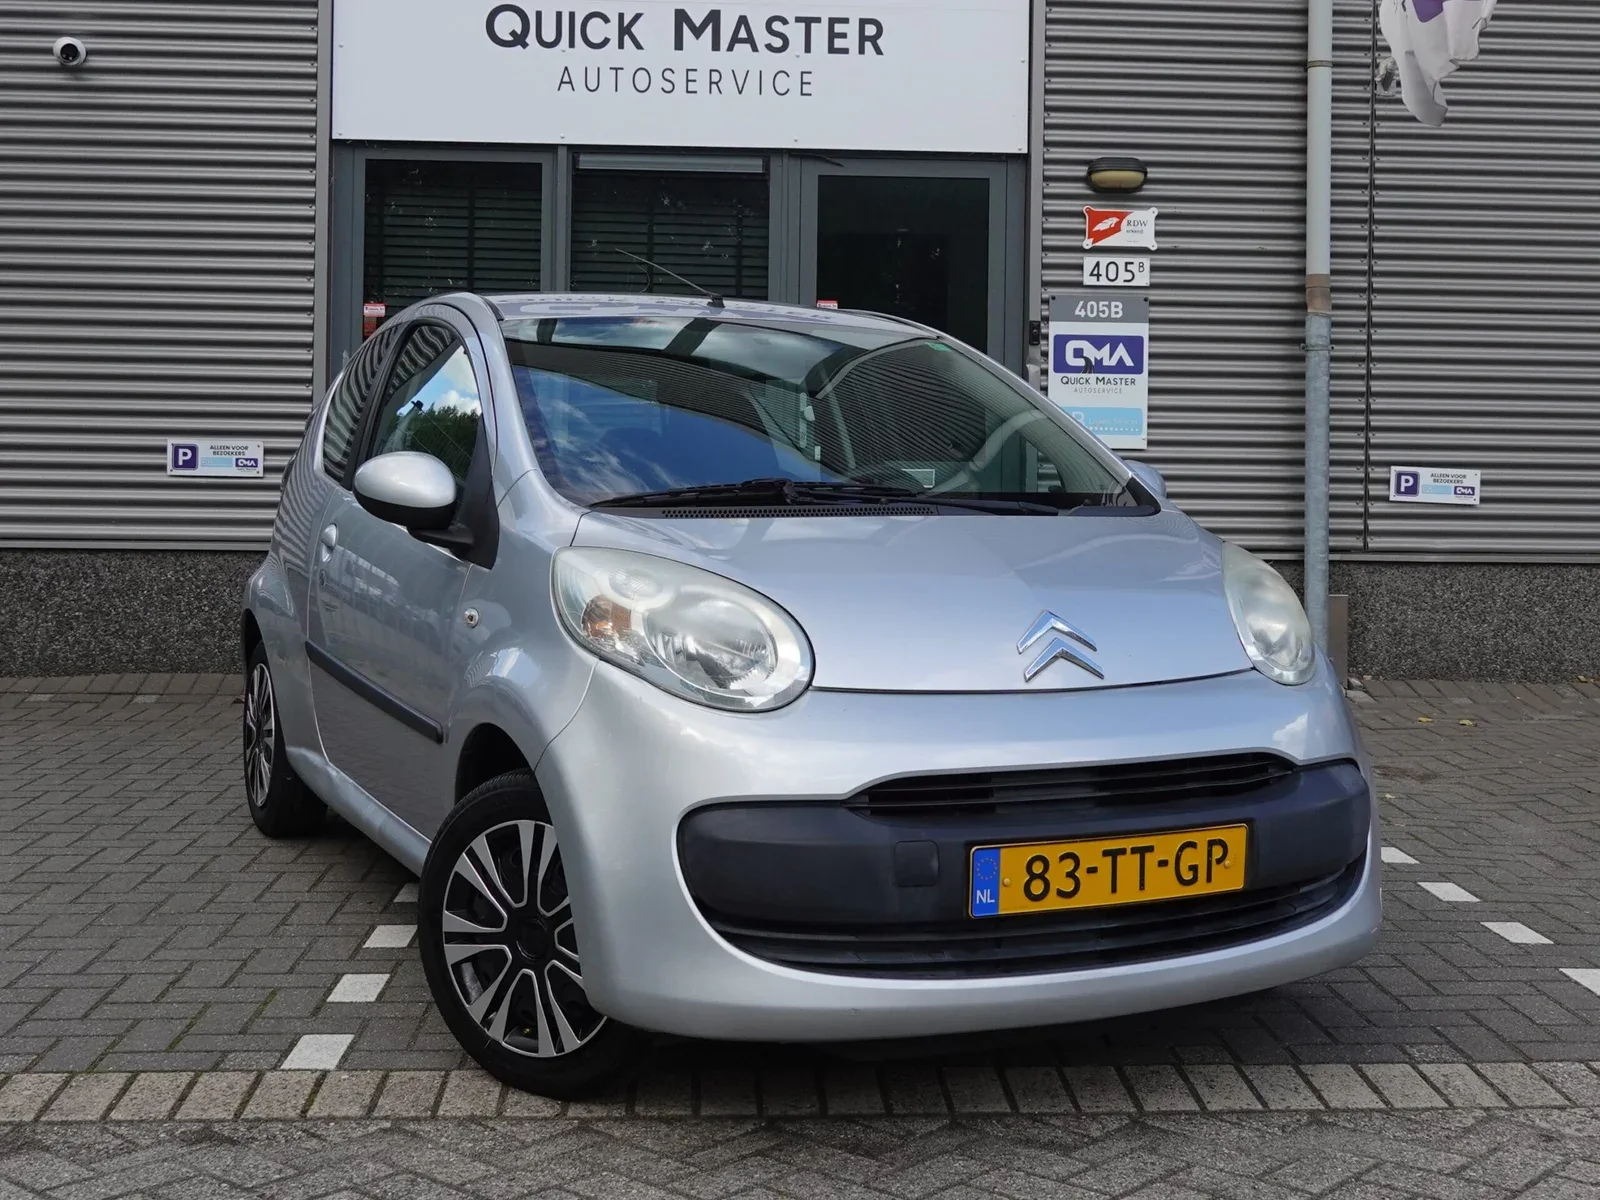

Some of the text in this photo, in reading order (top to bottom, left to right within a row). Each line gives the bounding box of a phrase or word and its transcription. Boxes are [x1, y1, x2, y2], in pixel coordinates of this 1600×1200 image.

[485, 3, 885, 56] QUICK MASTER
[557, 65, 813, 97] AUTOSERVICE
[1126, 219, 1149, 227] RDW
[1074, 300, 1123, 319] 405B
[1060, 375, 1136, 386] QUICK MASTER
[1073, 387, 1123, 395] AUTOSERVICE
[178, 448, 192, 466] P
[1400, 475, 1414, 492] P
[1023, 837, 1229, 902] 83-TT-GP
[976, 889, 996, 904] NL
